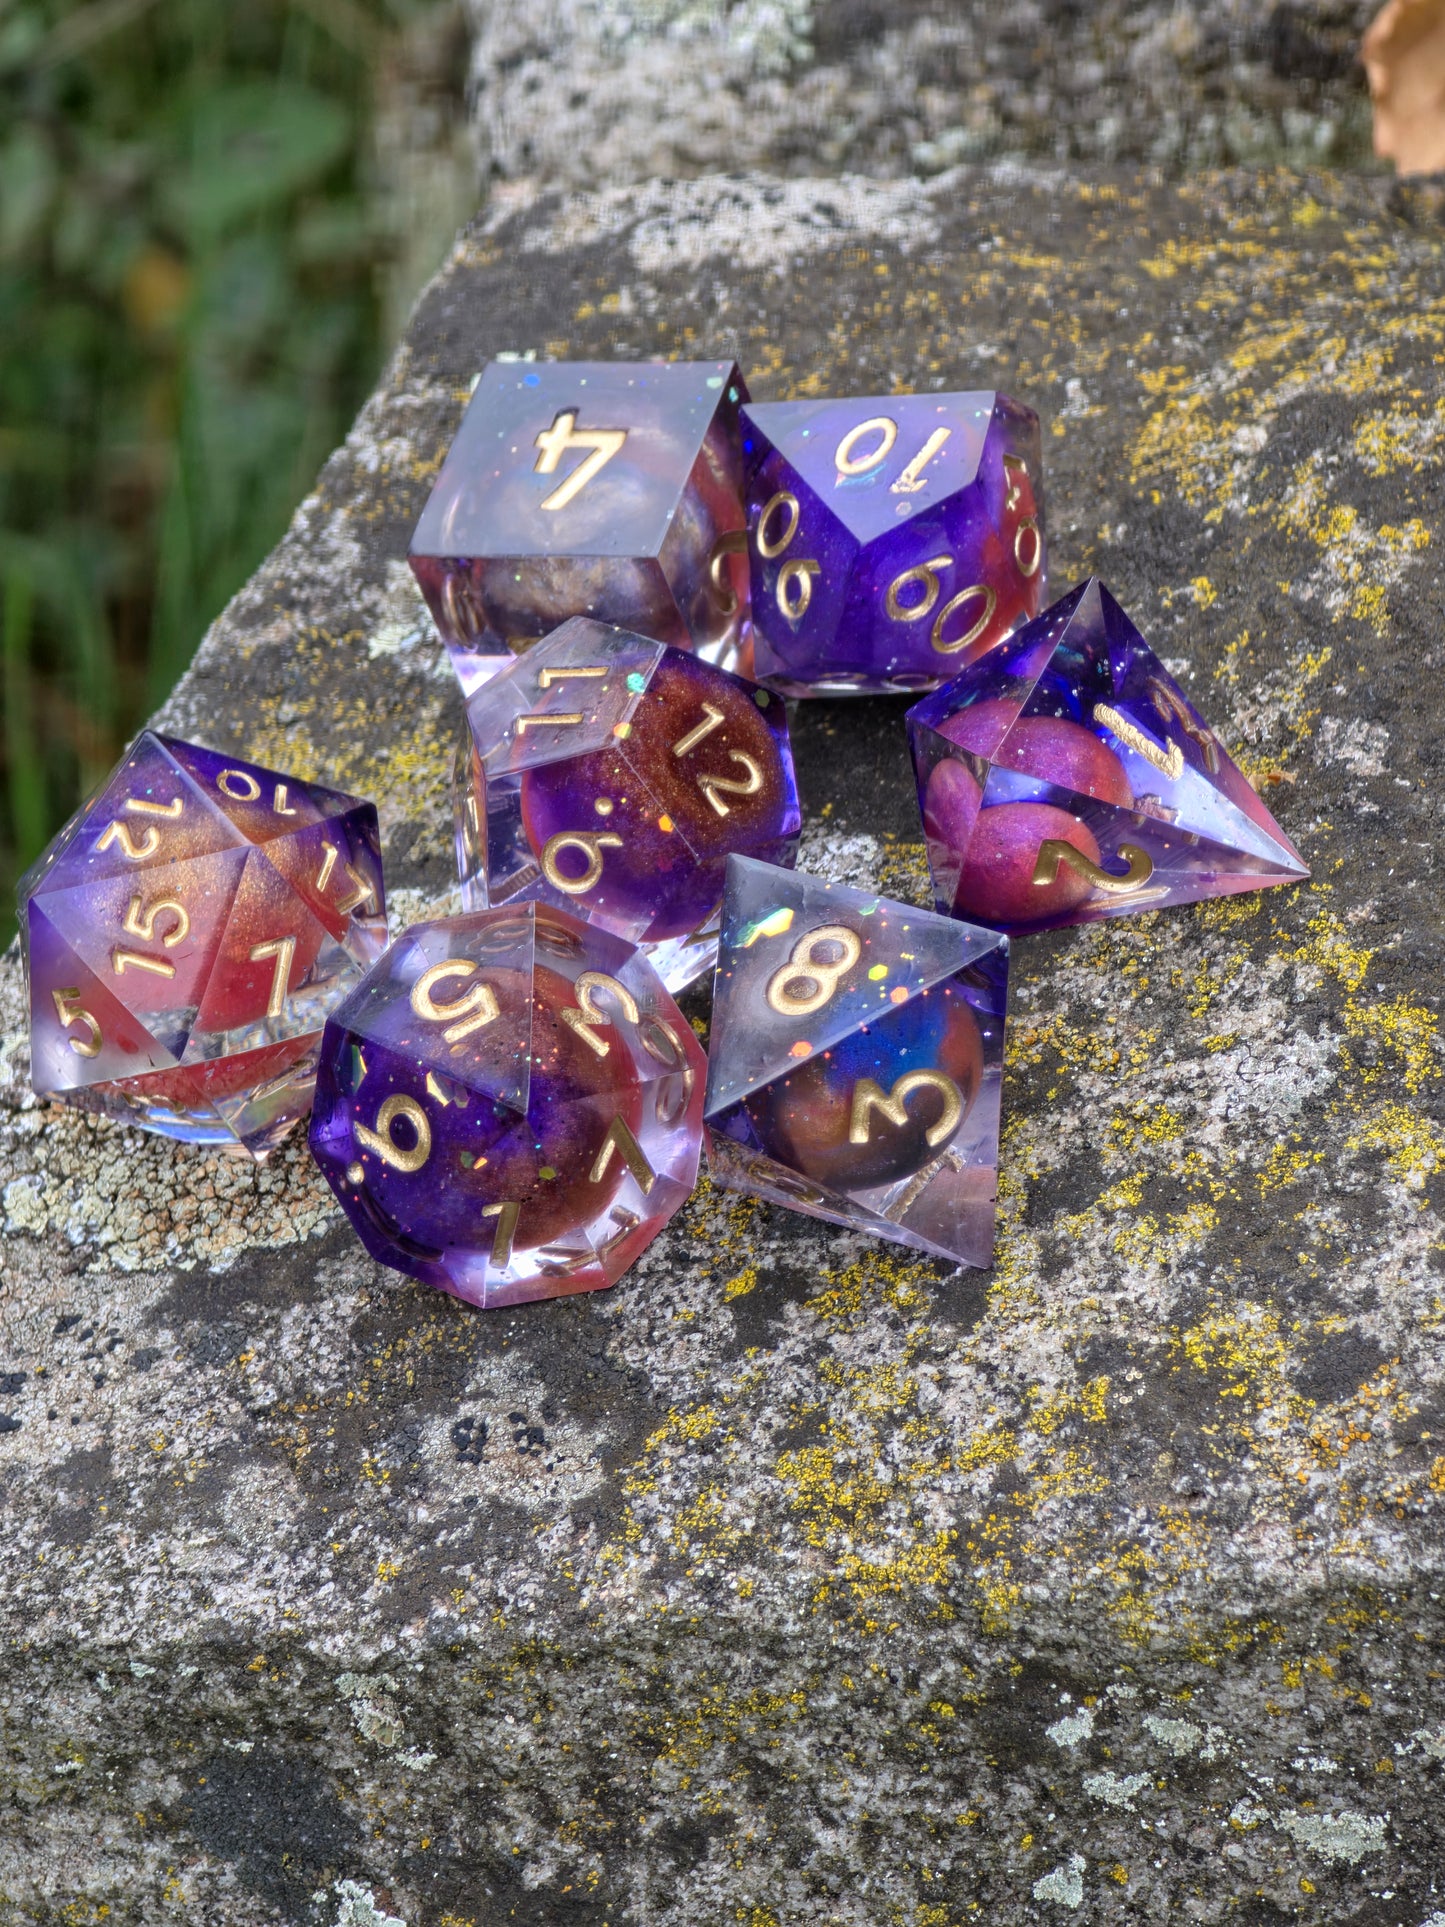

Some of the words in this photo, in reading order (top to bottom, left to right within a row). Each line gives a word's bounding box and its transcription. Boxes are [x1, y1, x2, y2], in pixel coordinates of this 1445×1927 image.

[533, 405, 630, 511] 4
[834, 416, 952, 494] 10
[516, 665, 610, 735] 11
[672, 702, 763, 817] 12
[1092, 702, 1185, 782] 1
[96, 796, 184, 860] 12
[215, 768, 297, 816] 10
[1031, 838, 1154, 893] 2
[111, 894, 191, 980] 15
[249, 935, 296, 1018] 7
[766, 923, 862, 1017] 8
[51, 986, 102, 1059] 5
[411, 958, 501, 1045] 5
[561, 970, 640, 1058] 3
[848, 1067, 965, 1147] 3
